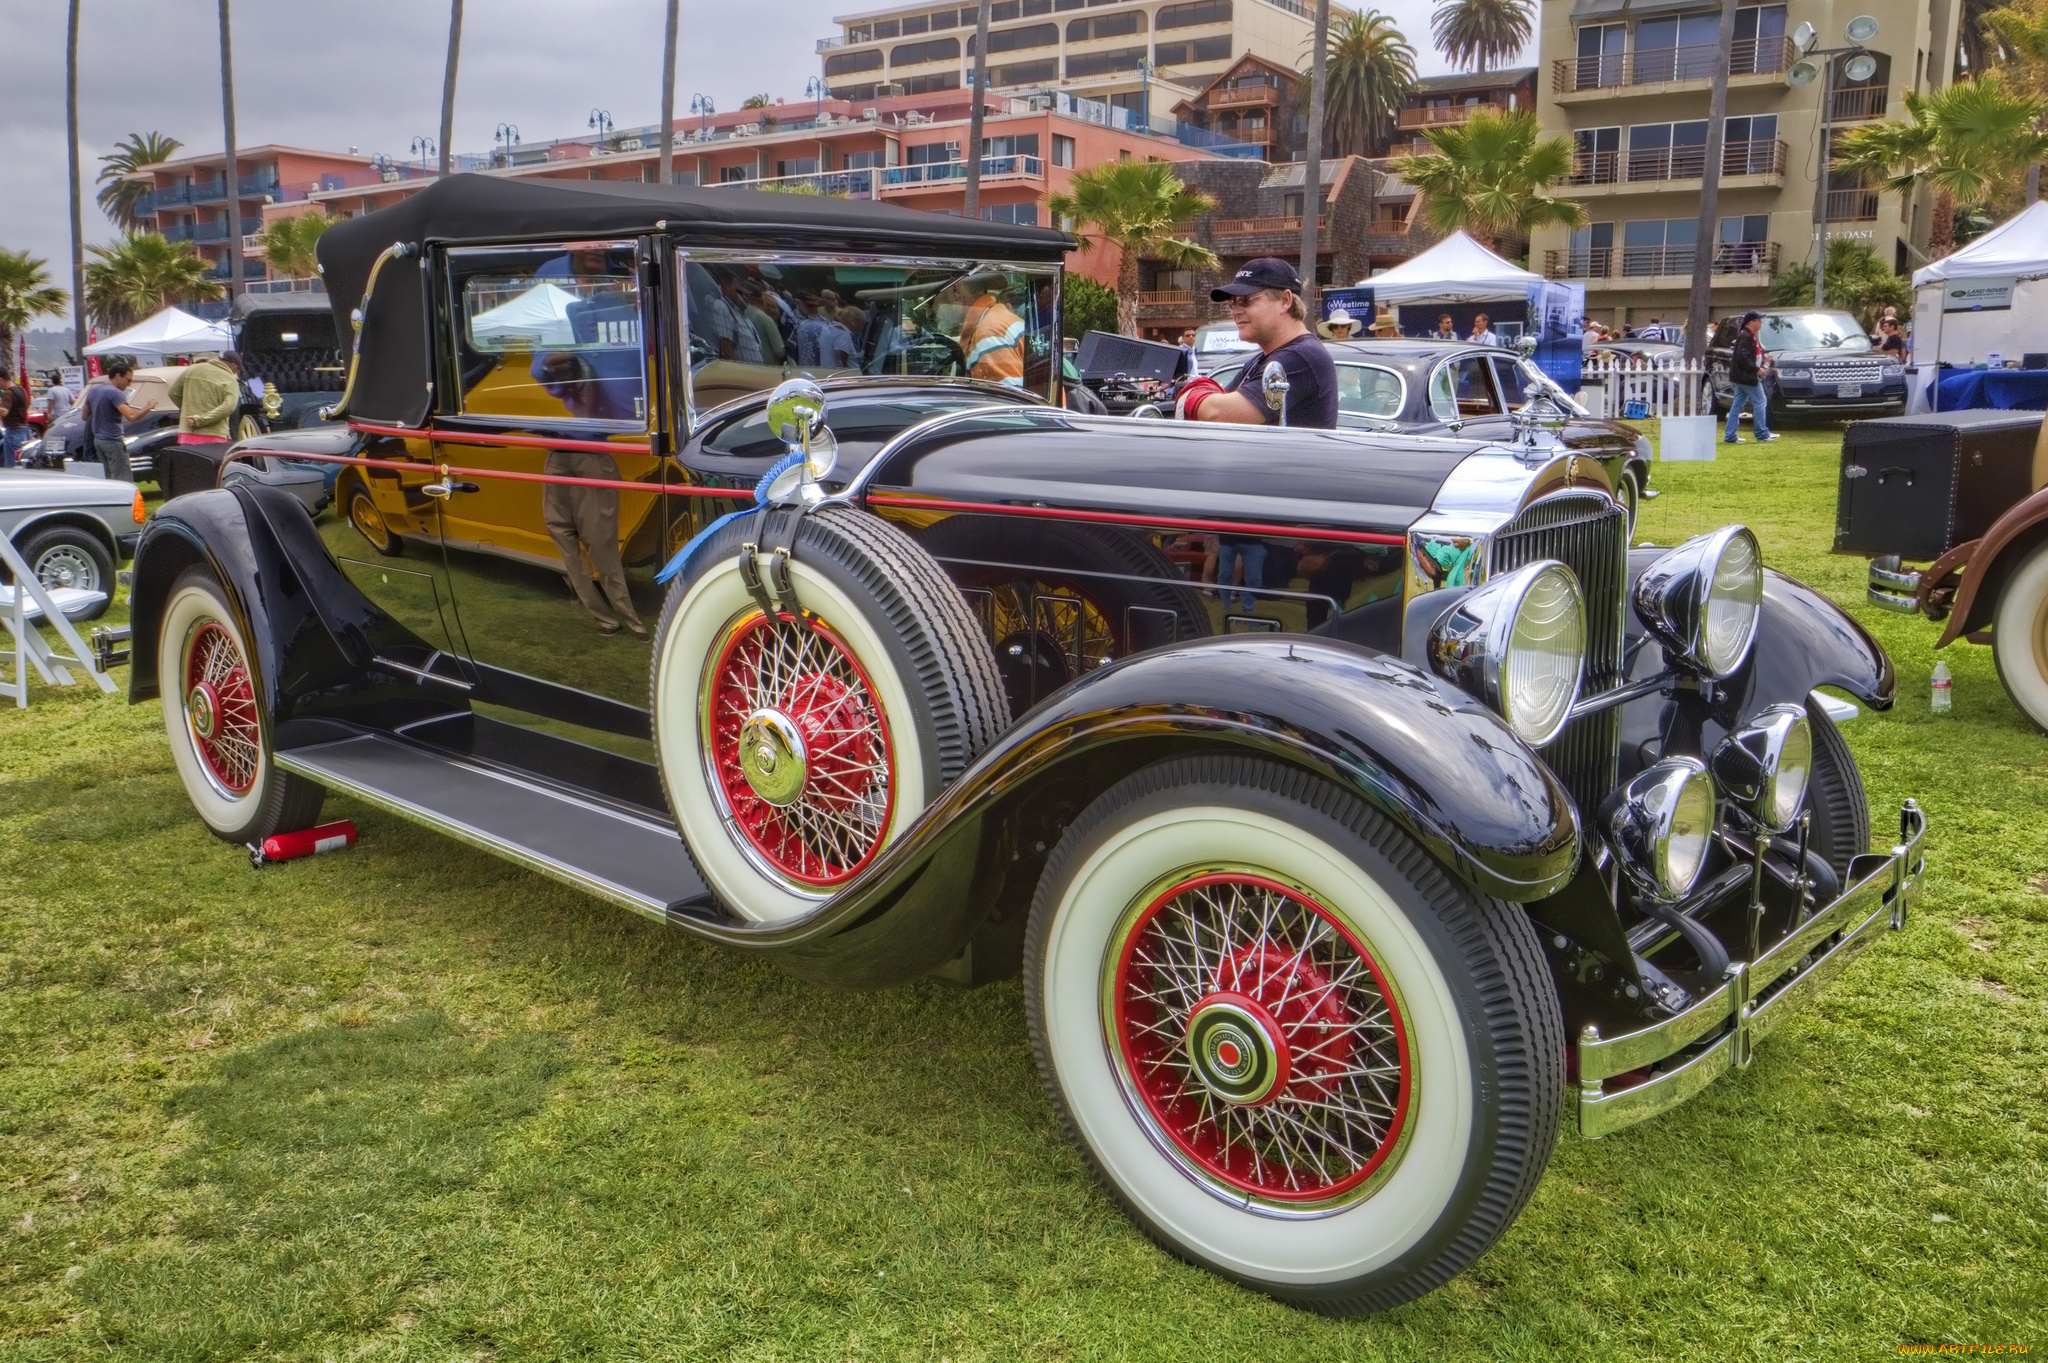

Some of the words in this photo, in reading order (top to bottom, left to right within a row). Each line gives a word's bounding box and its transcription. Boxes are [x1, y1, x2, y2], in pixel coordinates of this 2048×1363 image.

[1811, 232, 1831, 240] 113
[1836, 230, 1875, 239] COAST
[1332, 300, 1370, 308] Westime
